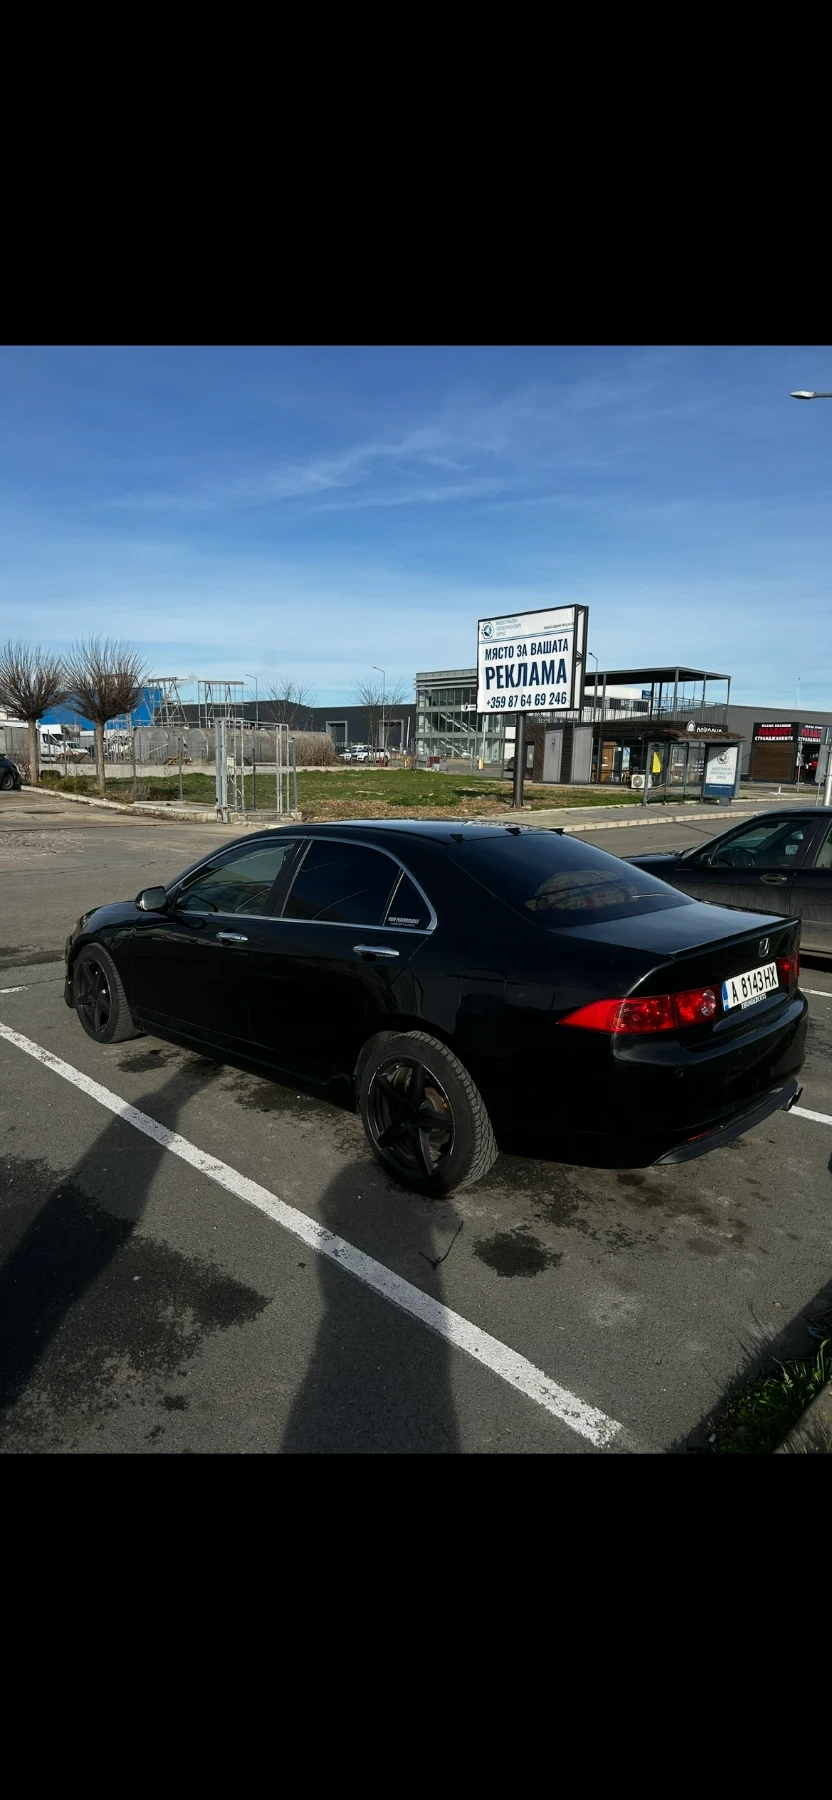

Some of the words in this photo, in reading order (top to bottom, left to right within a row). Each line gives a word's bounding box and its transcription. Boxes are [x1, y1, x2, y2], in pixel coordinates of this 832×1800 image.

[485, 646, 514, 661] МЯСТО
[517, 644, 528, 657] ЗА
[531, 638, 568, 656] ВАШАТА
[485, 658, 567, 690] РЕКЛАМА
[486, 696, 506, 709] +359
[508, 695, 518, 708] 87
[521, 694, 532, 707] 64
[535, 693, 546, 706] 69
[549, 692, 567, 706] 246
[758, 728, 793, 736] МЛАДОСТ
[801, 728, 823, 738] МЛАДО
[732, 981, 739, 1003] A
